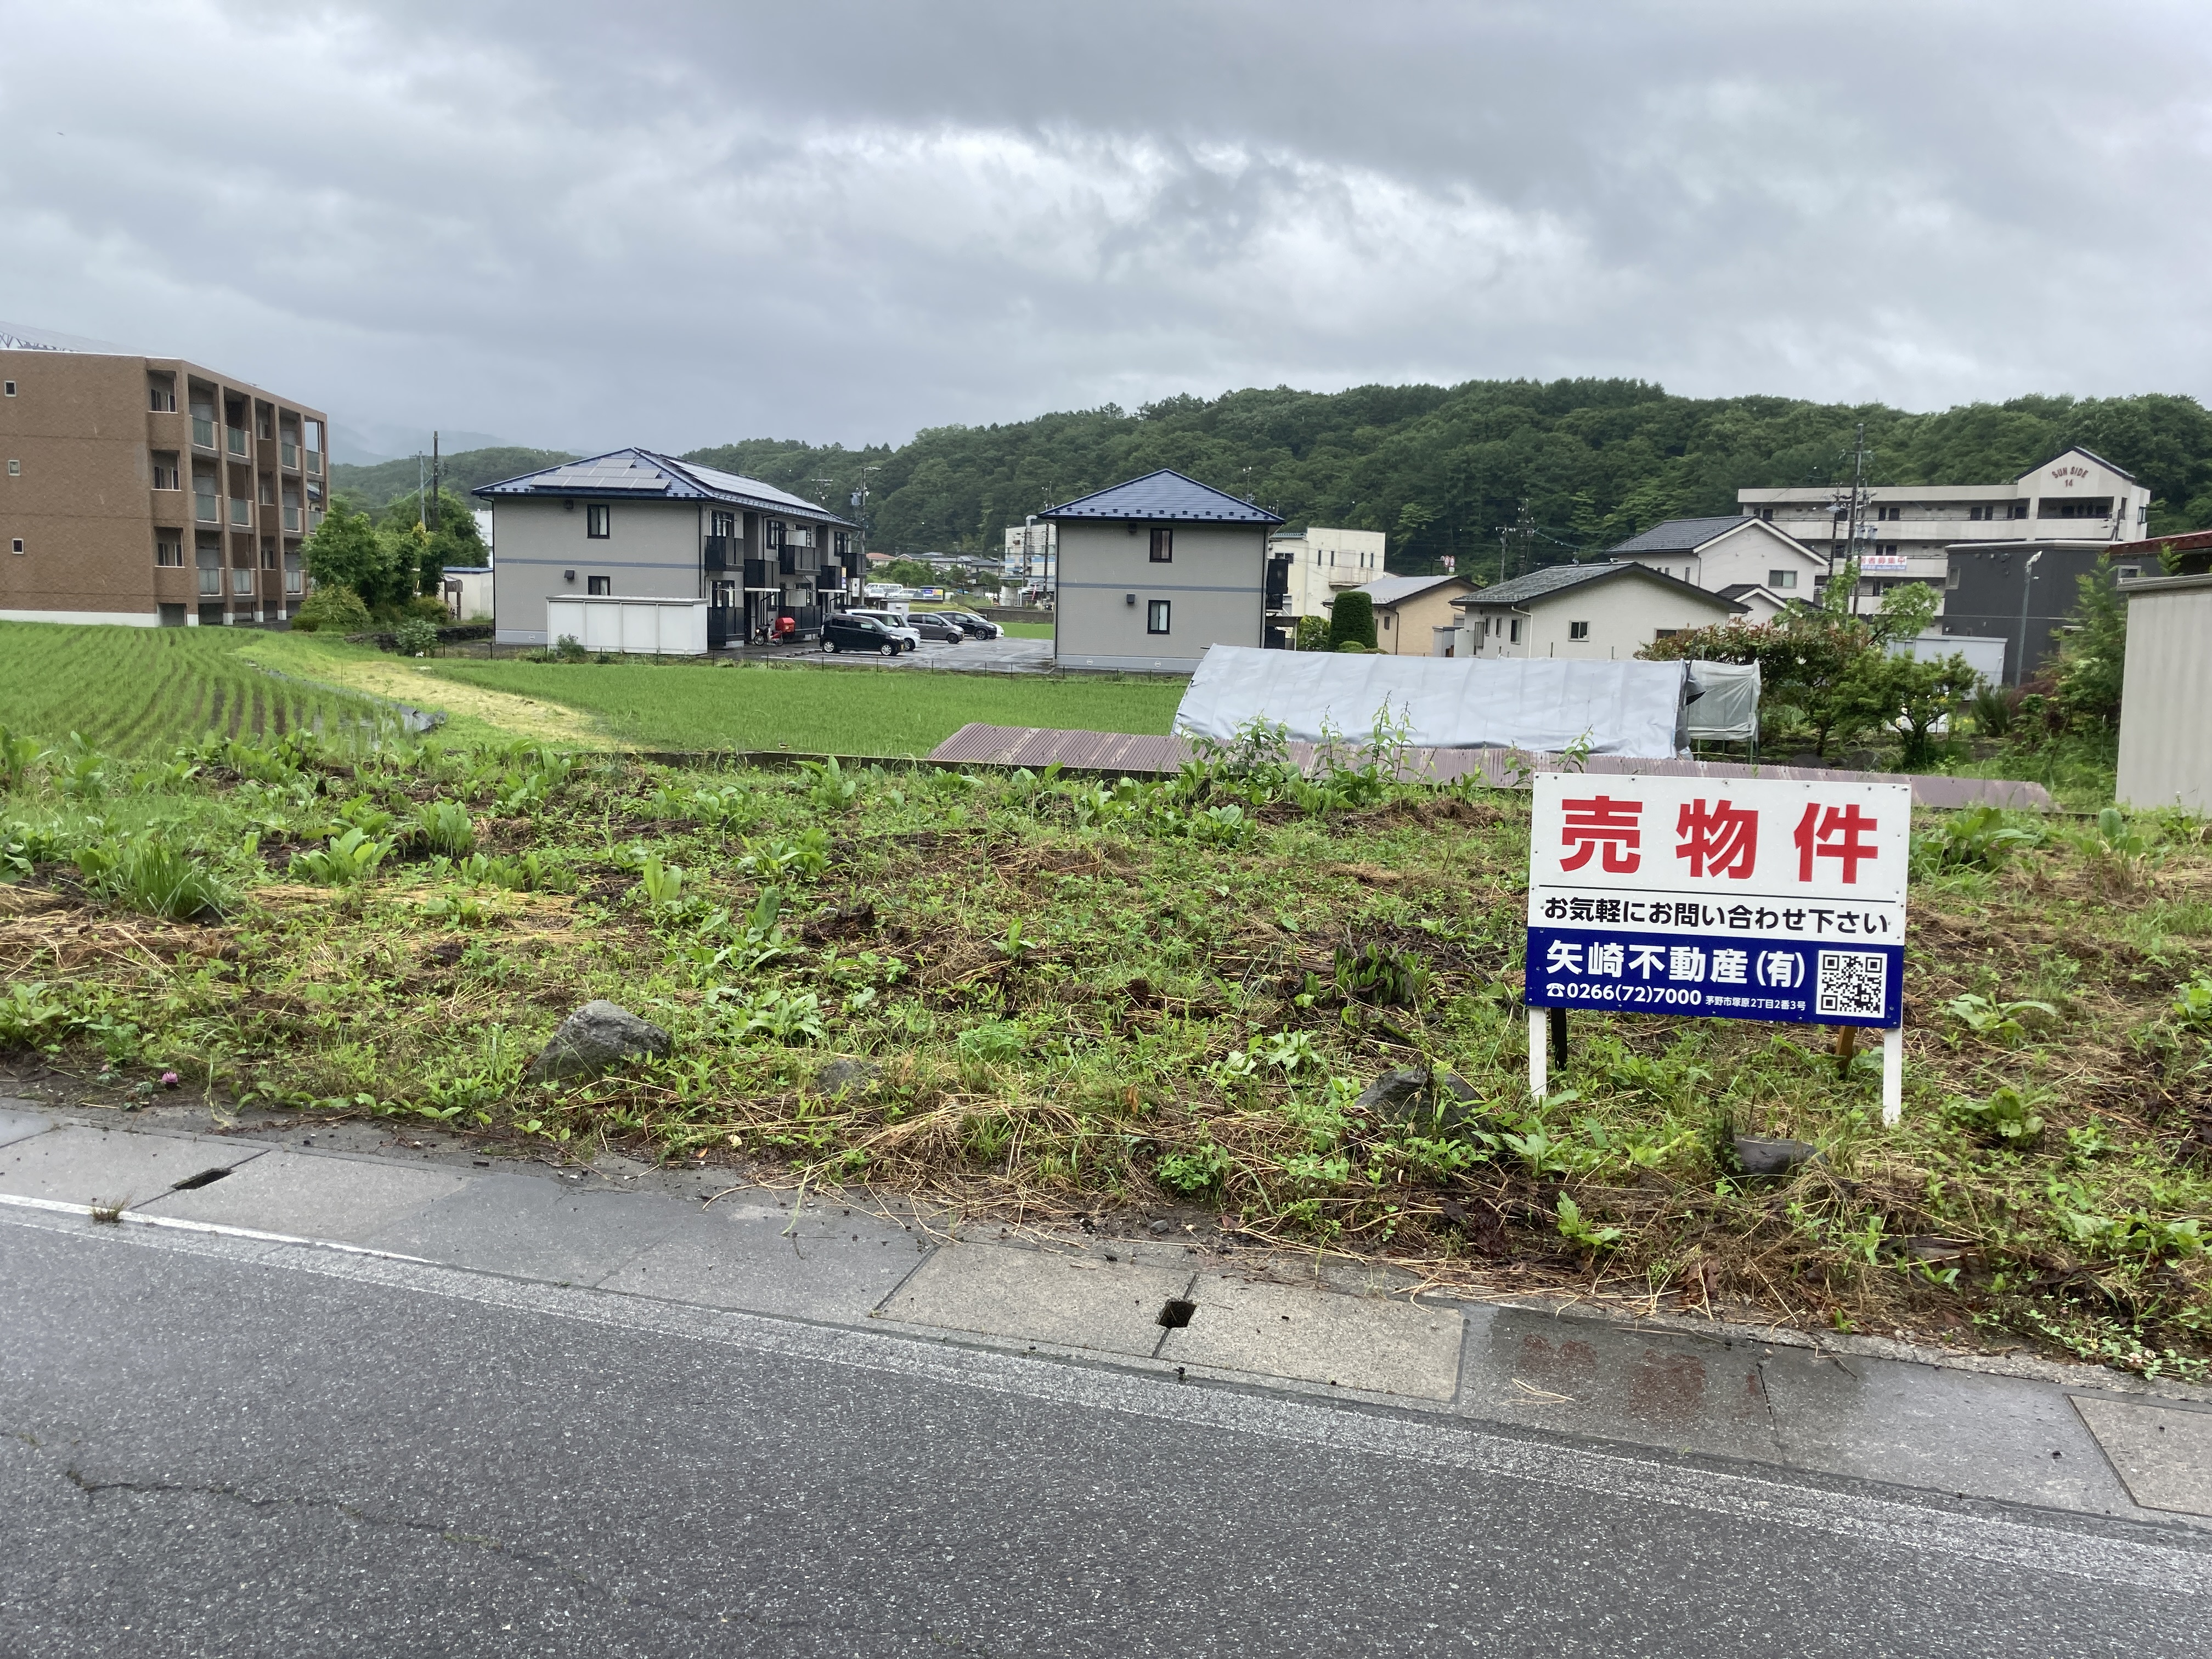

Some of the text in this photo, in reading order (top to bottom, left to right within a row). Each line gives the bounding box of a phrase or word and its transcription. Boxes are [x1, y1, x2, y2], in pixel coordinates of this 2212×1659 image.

[2052, 466, 2089, 478] SUN SIDE
[2064, 479, 2073, 488] 14
[1559, 795, 1878, 884] 売物件
[1544, 897, 1888, 934] お気軽にお問い合わせ下さい
[1546, 939, 1805, 988] 矢崎不動産(有)
[1567, 983, 1701, 1006] 0266(72)7000
[1705, 995, 1806, 1011] 茅野市塚原2丁目2番3号
